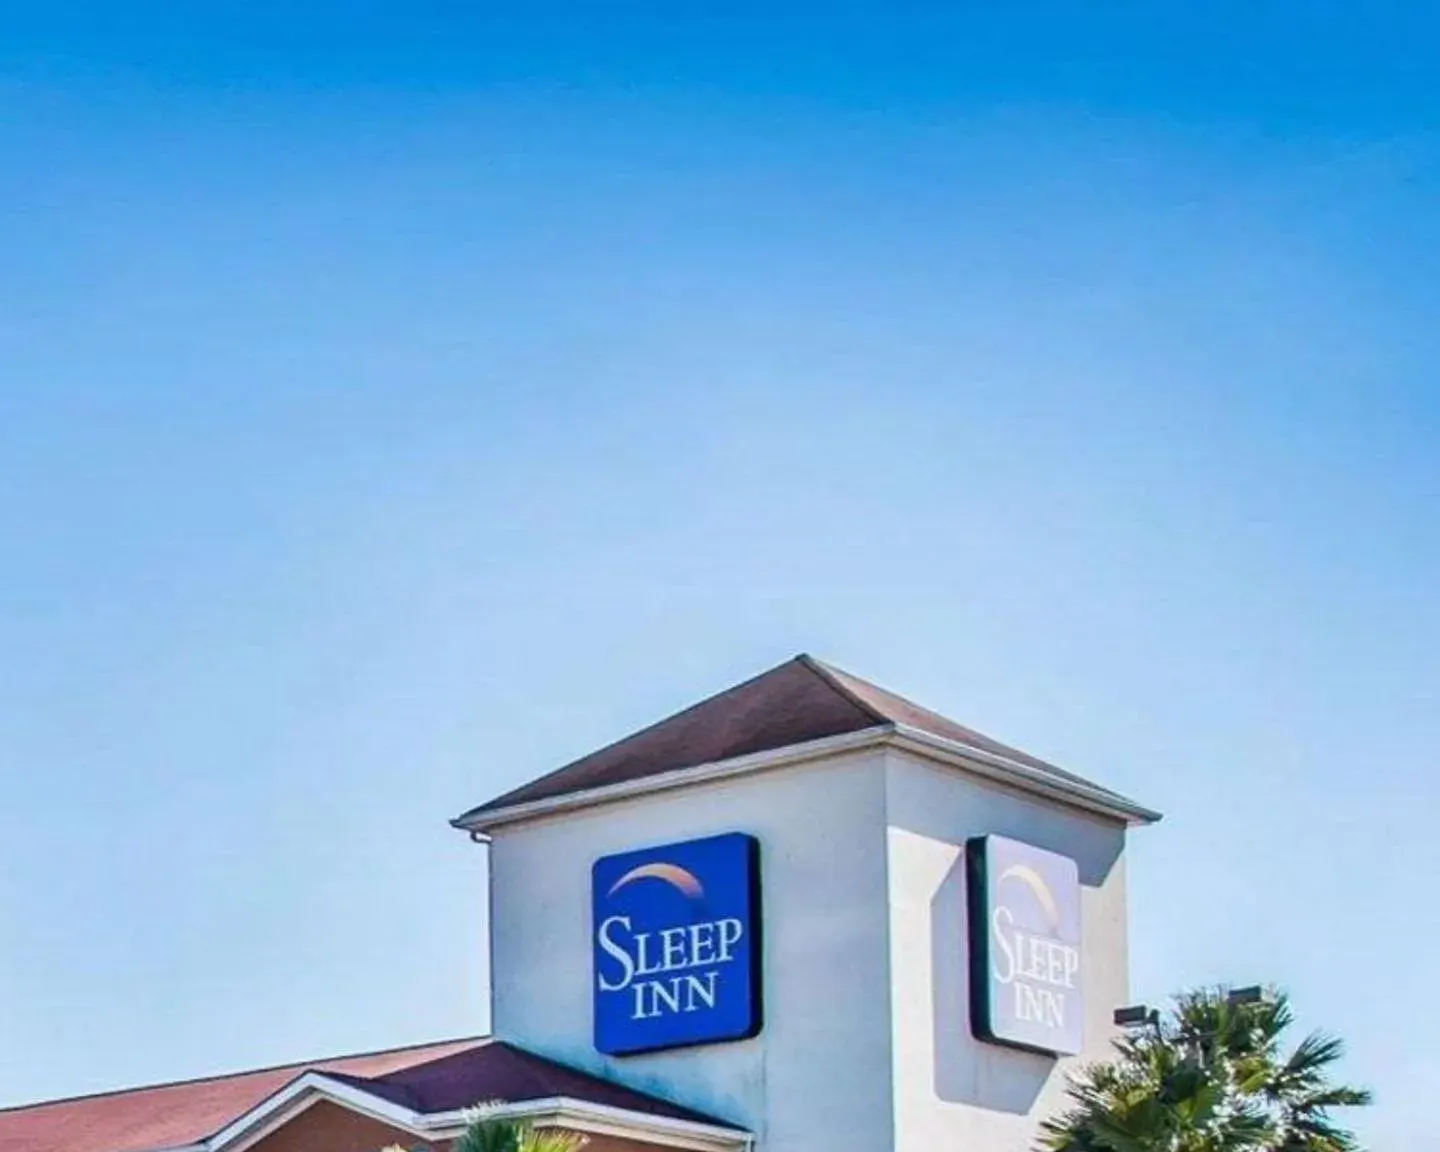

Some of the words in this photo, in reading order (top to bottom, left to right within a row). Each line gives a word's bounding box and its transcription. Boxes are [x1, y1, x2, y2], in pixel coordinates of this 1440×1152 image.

[598, 915, 743, 992] SLEEP
[993, 905, 1079, 989] SLEEP
[630, 971, 719, 1020] INN
[1013, 981, 1065, 1028] INN
